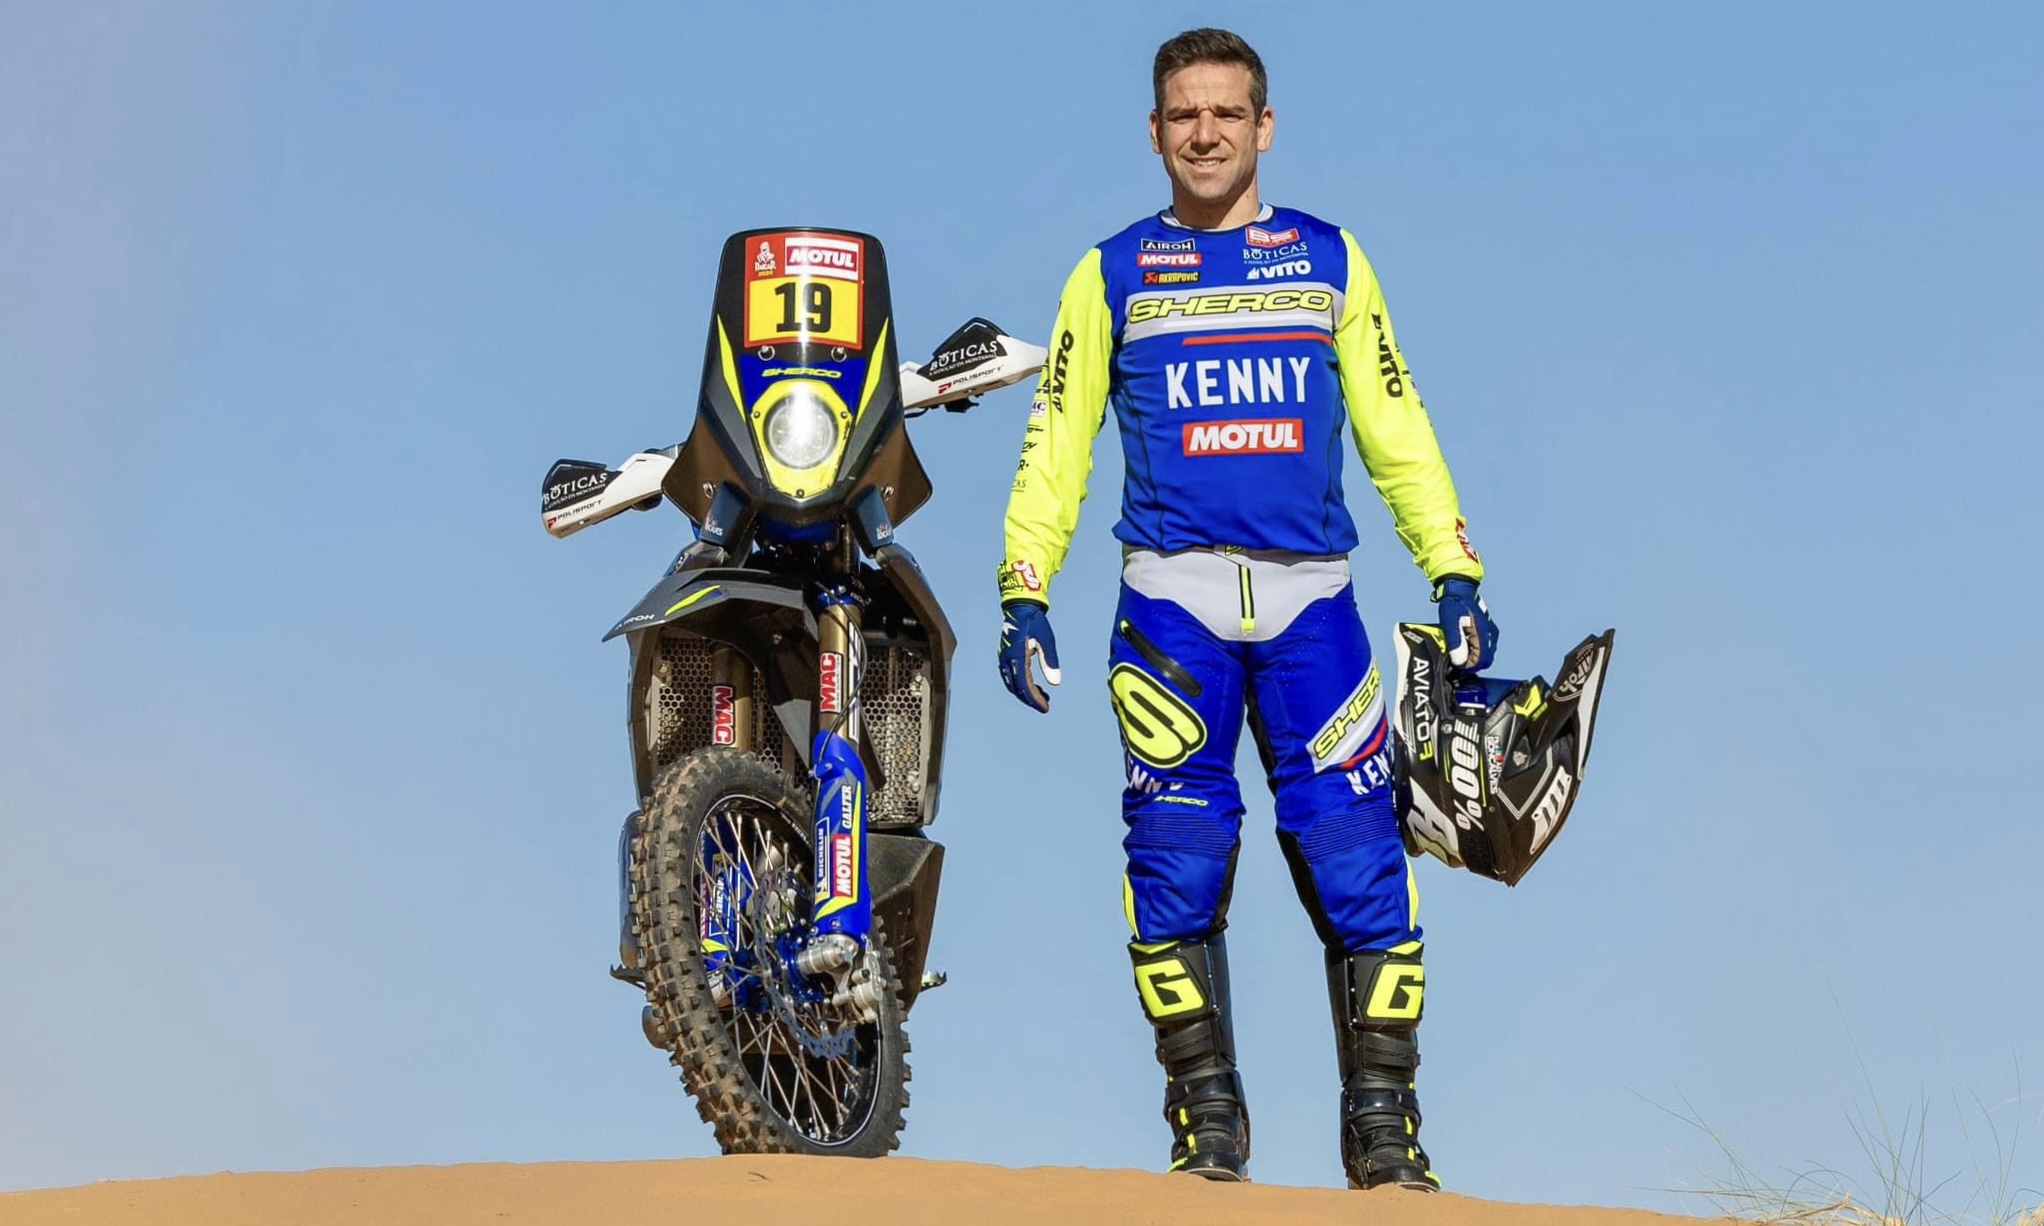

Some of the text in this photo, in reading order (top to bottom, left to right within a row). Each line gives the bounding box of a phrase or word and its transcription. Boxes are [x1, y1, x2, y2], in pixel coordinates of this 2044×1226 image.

[789, 248, 855, 268] MOTUL
[1140, 253, 1198, 266] MOTUL
[1145, 240, 1192, 251] AIROH
[1242, 241, 1308, 260] BOTICAS
[1260, 260, 1312, 279] VITO
[774, 281, 832, 334] 19
[1129, 289, 1333, 324] SHERCO
[761, 367, 843, 379] SHERCO
[929, 340, 998, 371] BOTICAS
[1052, 329, 1075, 396] VITO
[1165, 356, 1311, 410] KENNY
[1189, 422, 1298, 452] MOTUL
[542, 472, 608, 505] BOTICAS
[820, 652, 837, 713] MAC
[713, 686, 735, 746] MAC
[1111, 664, 1204, 765] S
[1451, 718, 1485, 832] 100%
[840, 785, 854, 829] GALFER
[1155, 794, 1208, 807] HERCO
[817, 828, 826, 880] MICHELIN
[835, 835, 854, 897] MOTUL
[1135, 958, 1204, 1018] G
[1366, 963, 1424, 1019] G
